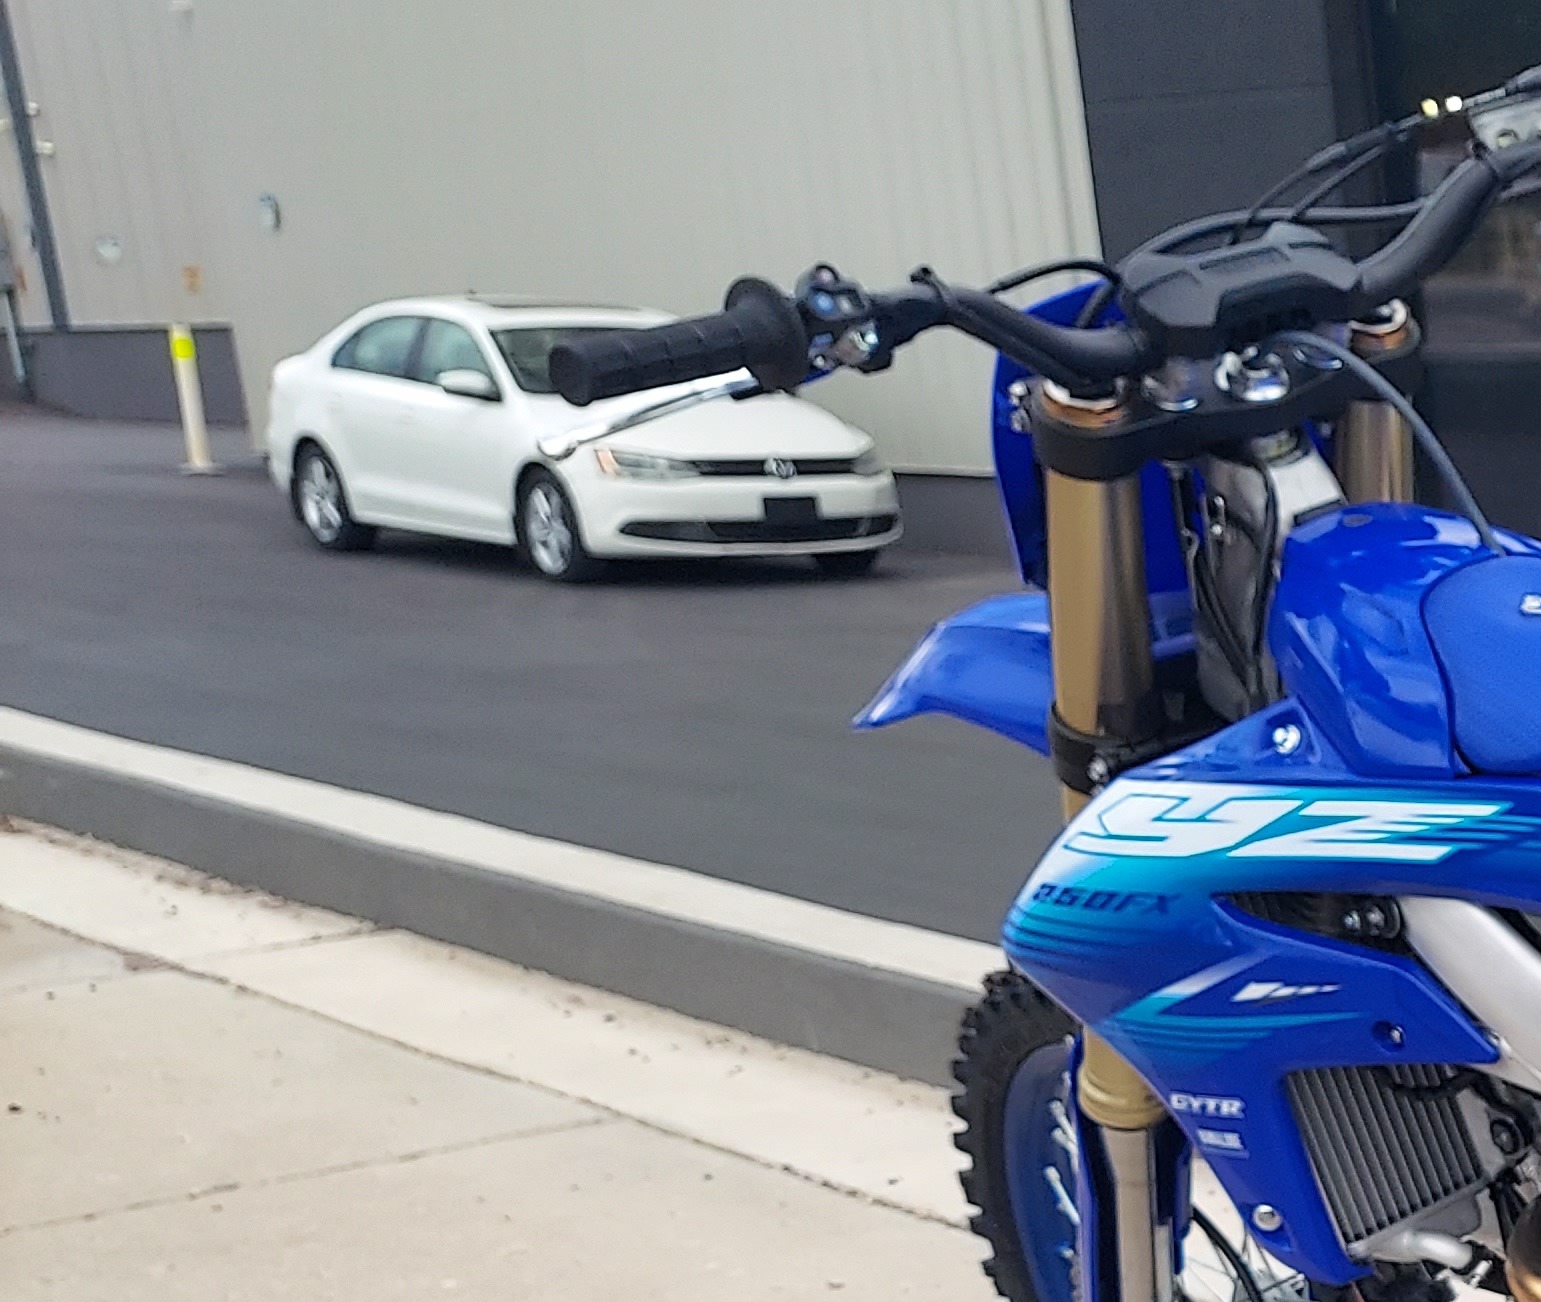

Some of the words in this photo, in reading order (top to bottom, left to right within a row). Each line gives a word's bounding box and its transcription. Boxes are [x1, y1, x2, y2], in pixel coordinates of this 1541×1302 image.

[1060, 792, 1505, 863] YZ
[1033, 882, 1182, 915] 250FX
[1169, 1091, 1247, 1120] GYTR
